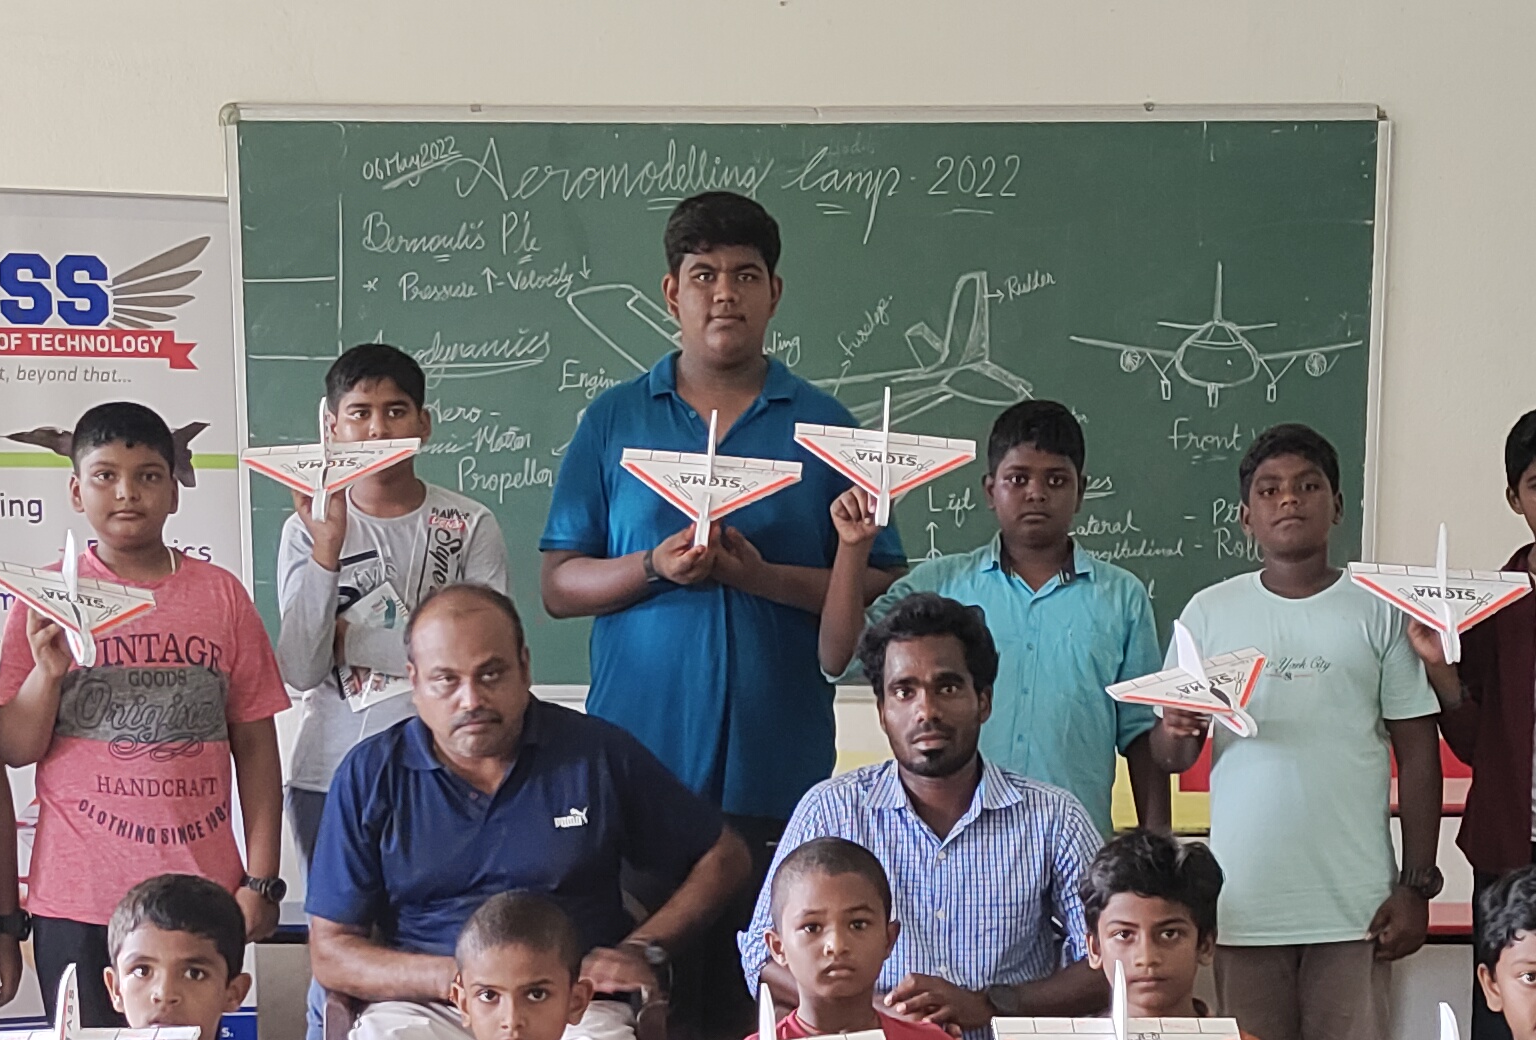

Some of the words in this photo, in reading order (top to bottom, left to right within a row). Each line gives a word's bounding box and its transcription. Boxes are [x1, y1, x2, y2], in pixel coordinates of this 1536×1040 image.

[928, 154, 1020, 198] 2022
[28, 334, 163, 354] TECHNOLOGY
[16, 365, 78, 386] beyond
[1068, 509, 1141, 536] ateral
[128, 670, 187, 687] GOODS
